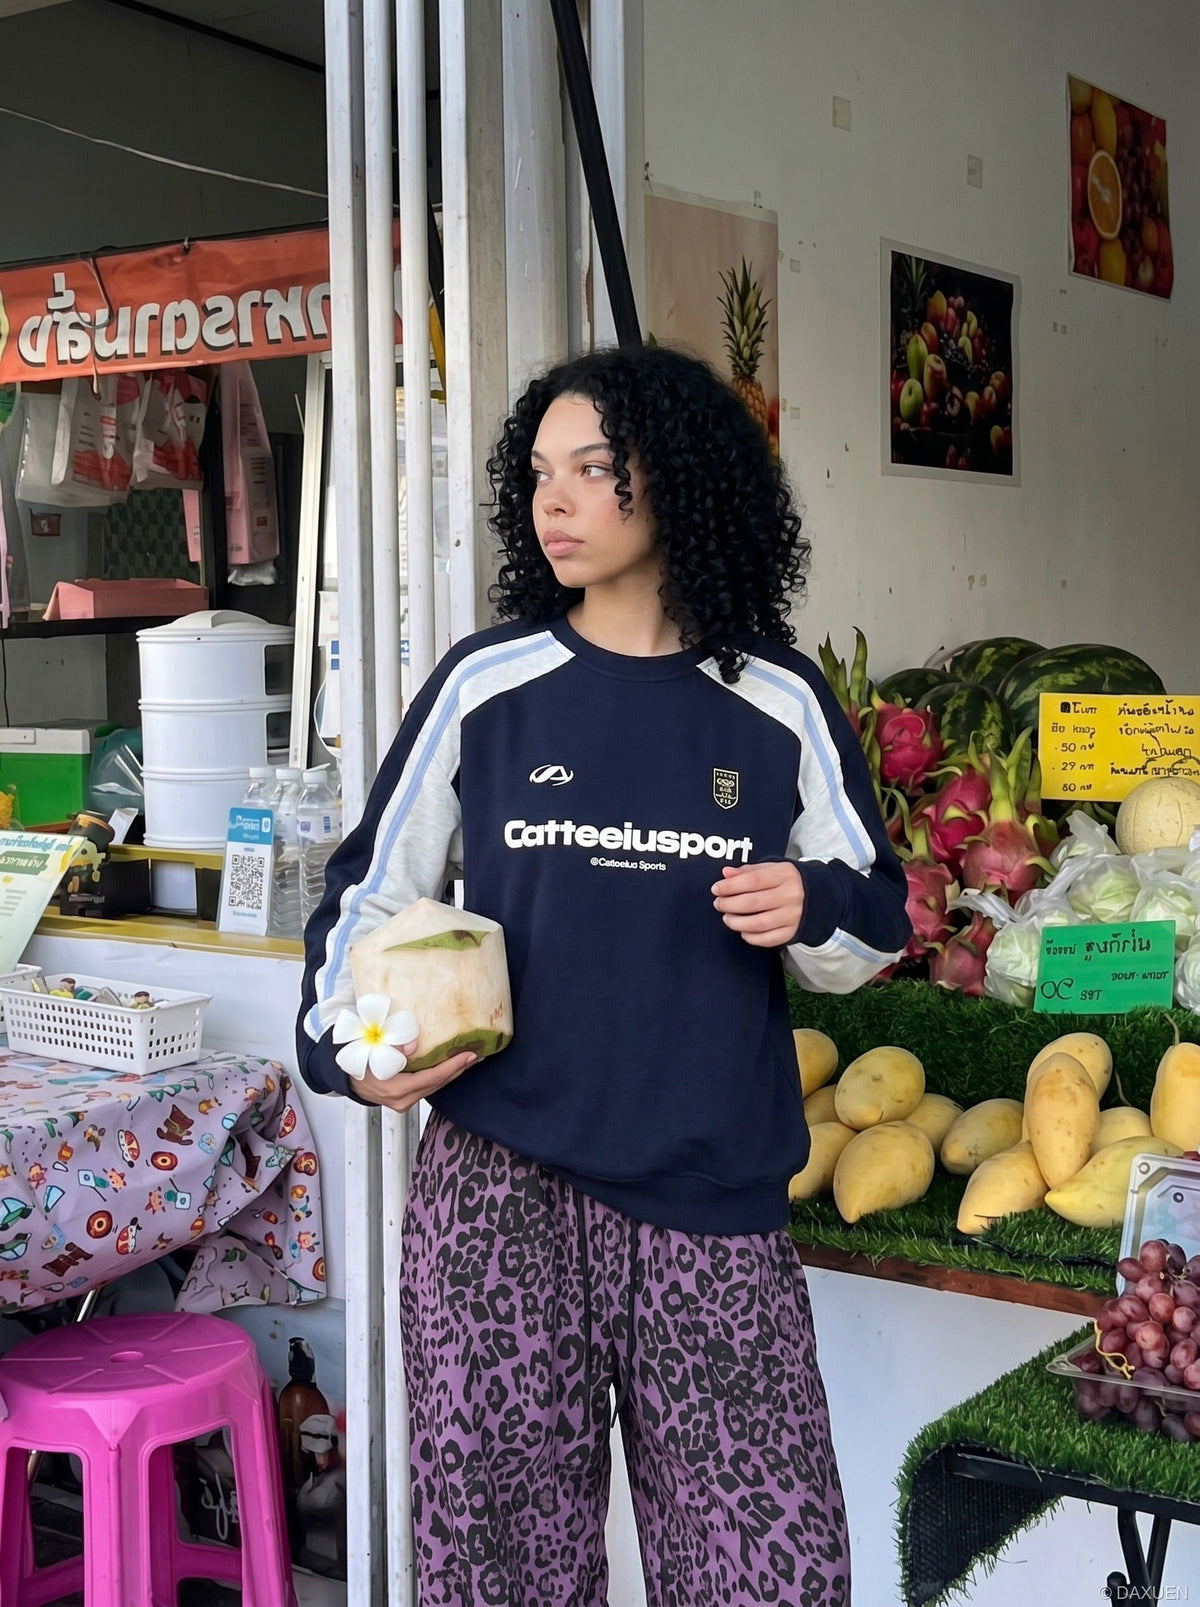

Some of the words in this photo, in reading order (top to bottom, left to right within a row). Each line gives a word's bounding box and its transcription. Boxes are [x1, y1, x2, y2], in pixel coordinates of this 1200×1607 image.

[1061, 761, 1076, 771] 29
[504, 819, 753, 863] Catteeiusport
[639, 860, 667, 872] Sports
